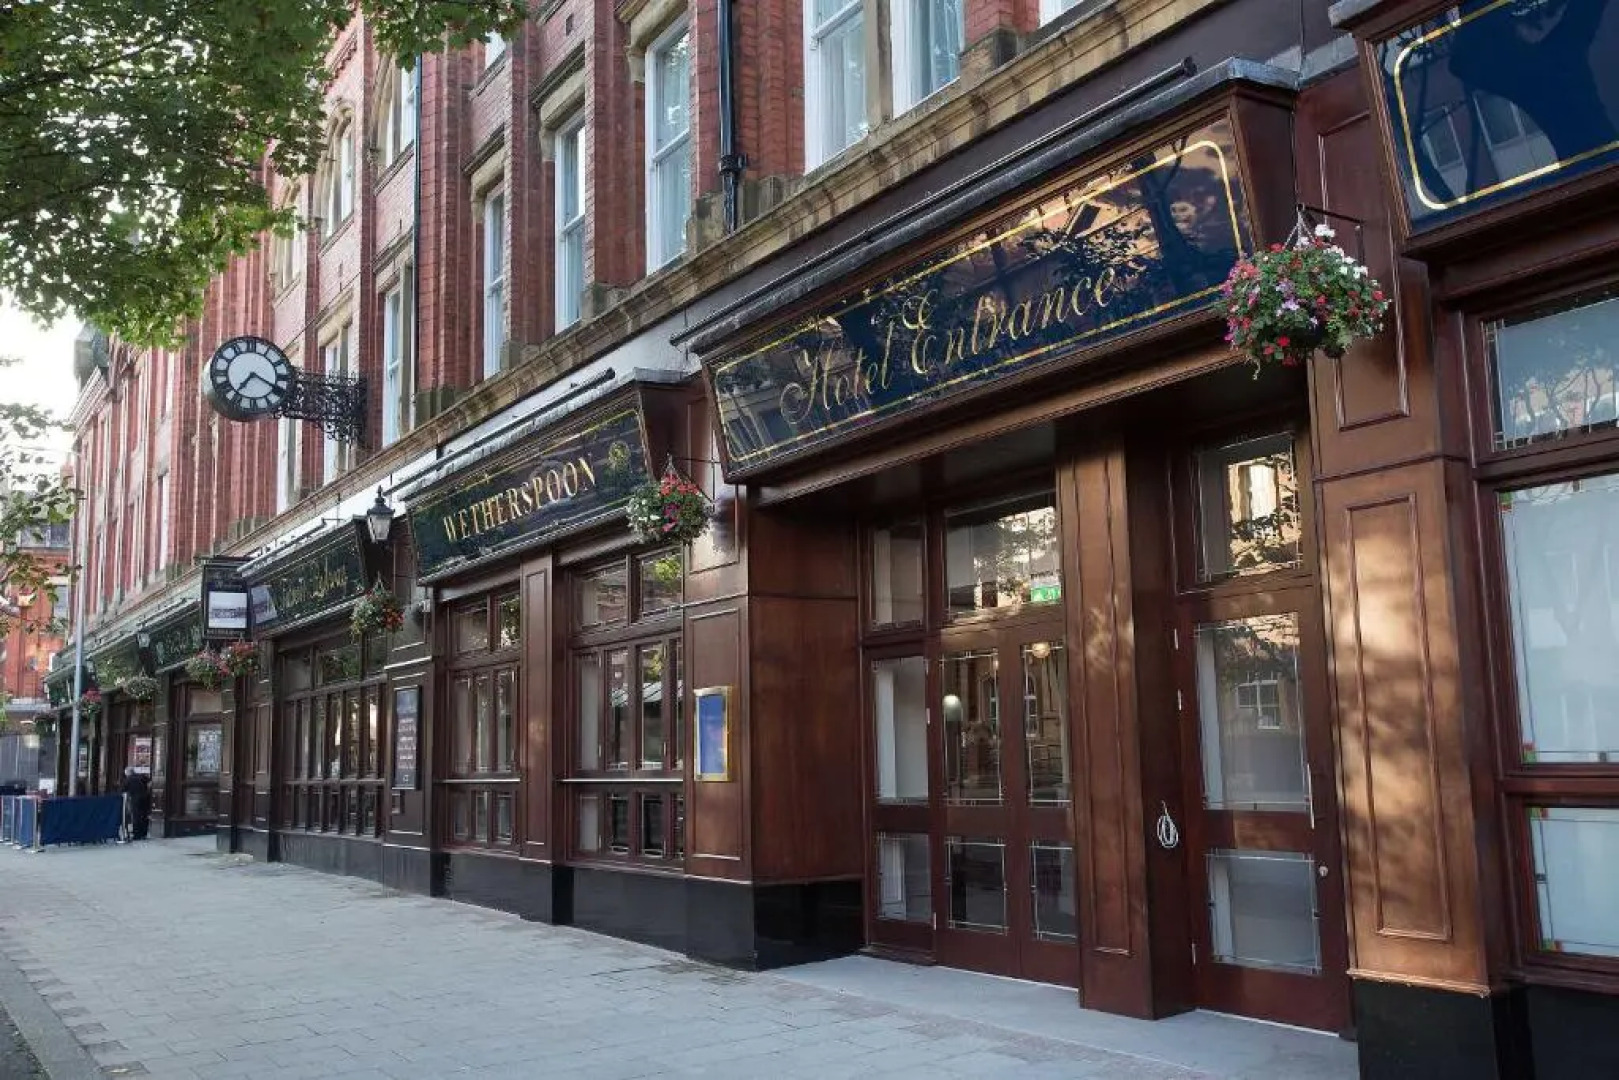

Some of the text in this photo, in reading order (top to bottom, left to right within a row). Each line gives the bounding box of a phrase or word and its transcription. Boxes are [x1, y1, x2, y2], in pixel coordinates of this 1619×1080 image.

[780, 264, 1116, 424] Hotel Entrance
[443, 452, 597, 544] WETHERSPOON
